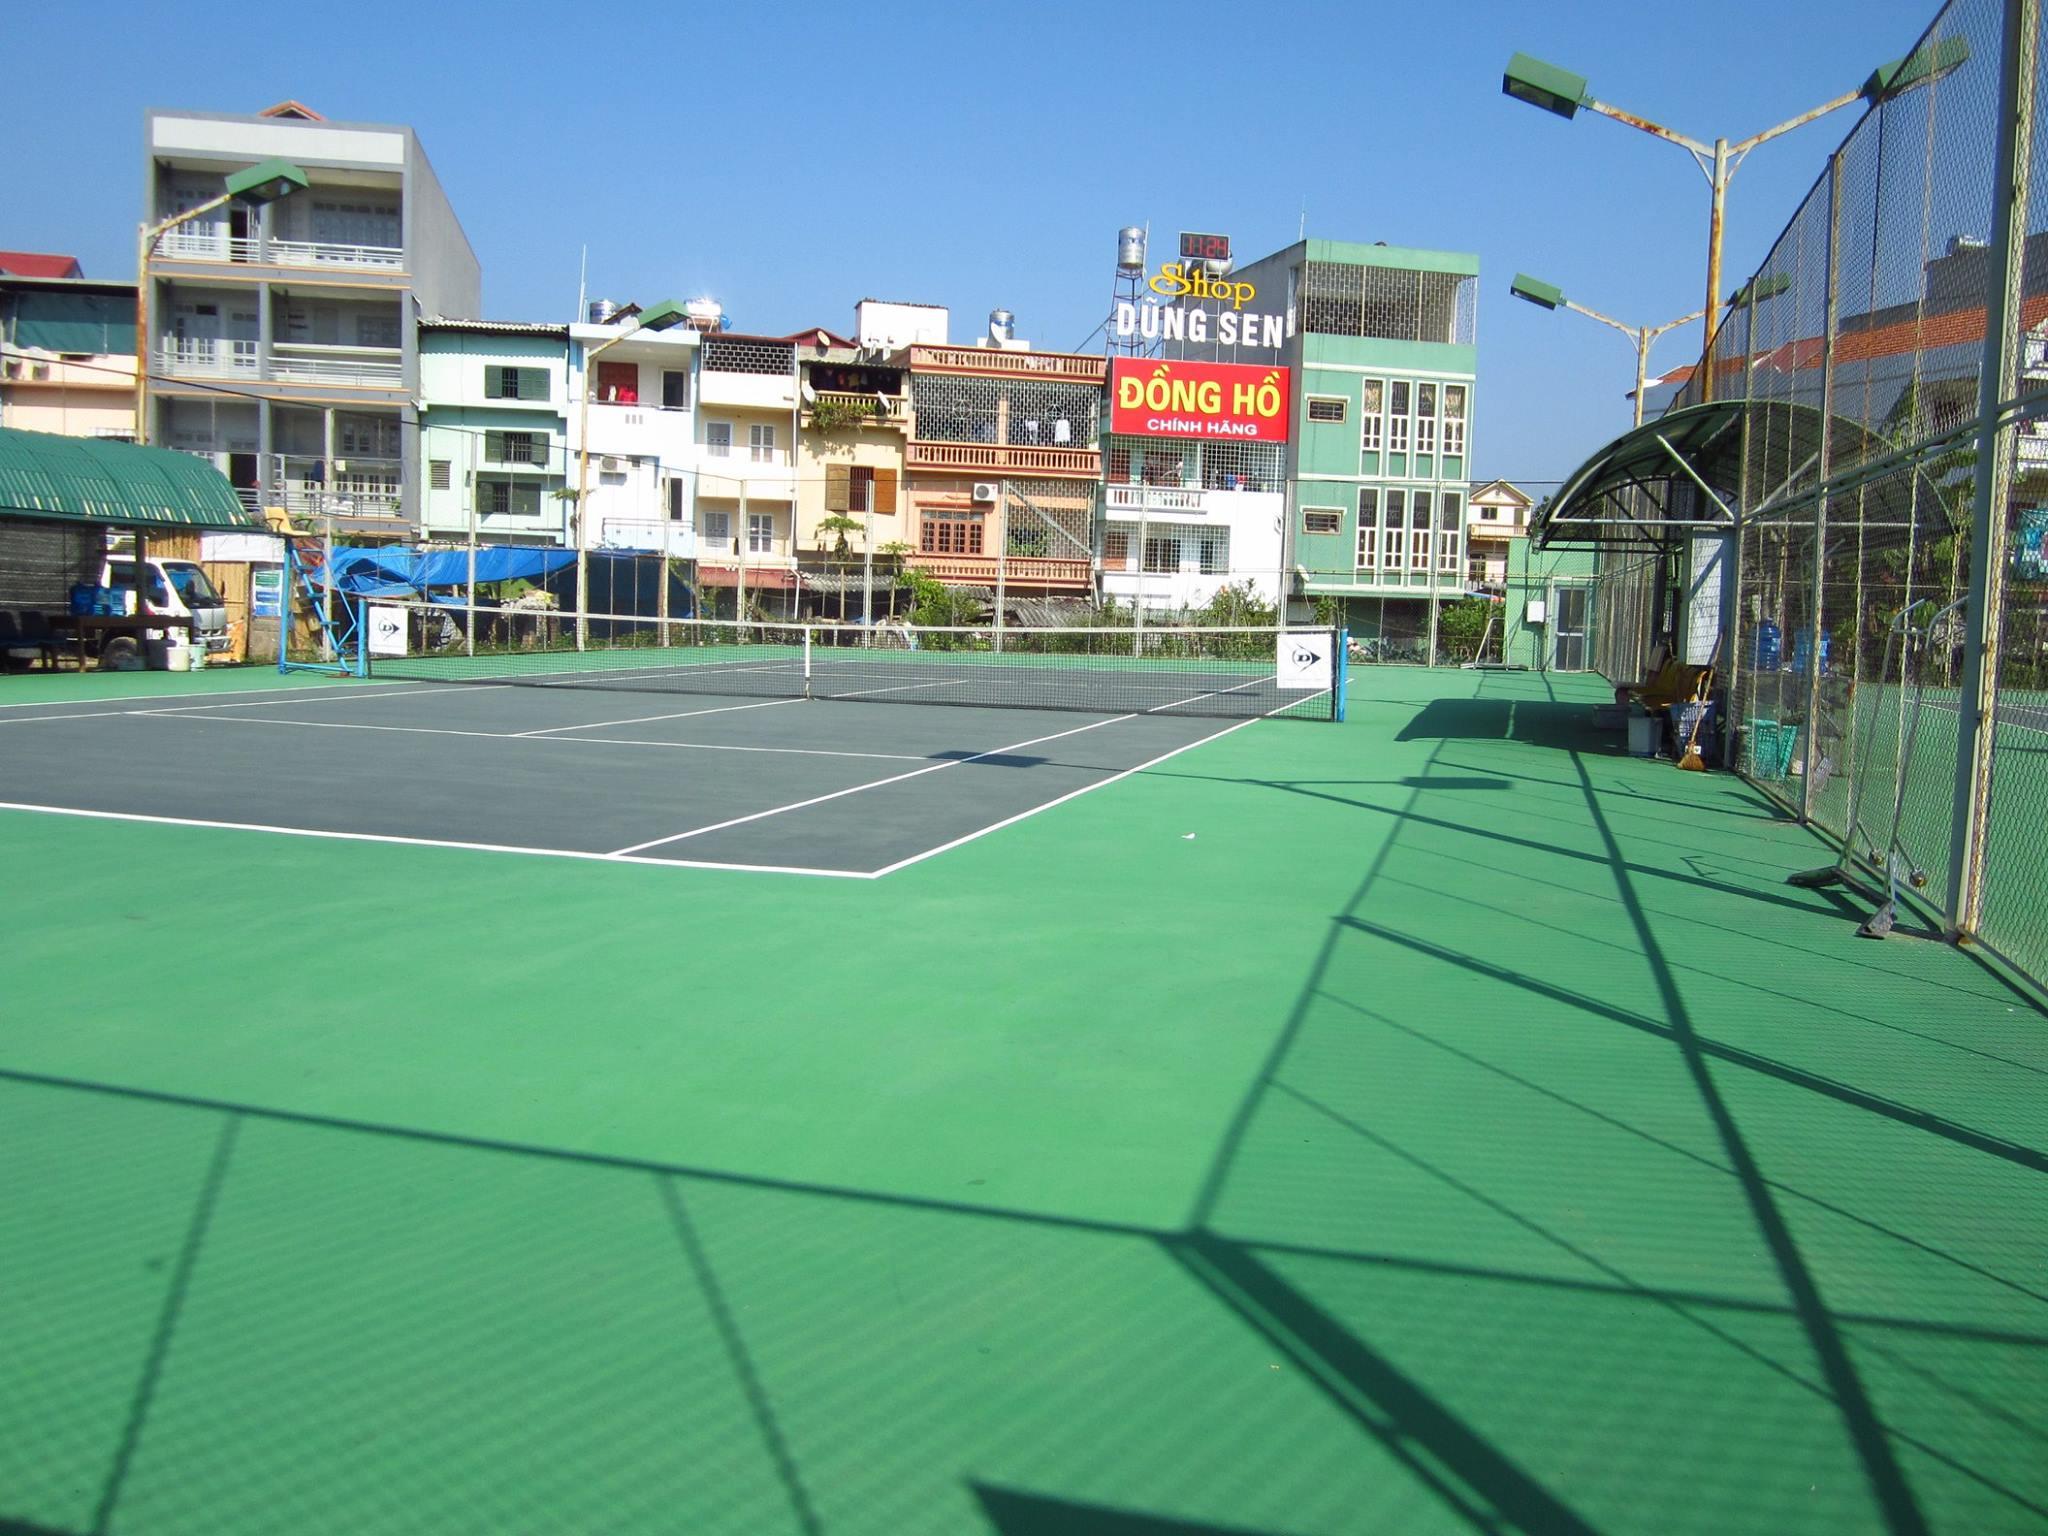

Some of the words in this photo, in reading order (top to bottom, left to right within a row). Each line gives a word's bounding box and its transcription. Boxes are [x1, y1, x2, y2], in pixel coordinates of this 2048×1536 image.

[1148, 262, 1256, 310] Shop
[1117, 297, 1207, 343] DŨNG
[1219, 311, 1283, 348] SEN
[1118, 364, 1221, 414] ĐỒNG
[1233, 371, 1281, 418] HỒ
[1147, 417, 1202, 433] CHÍNH
[1207, 420, 1258, 436] HÃNG
